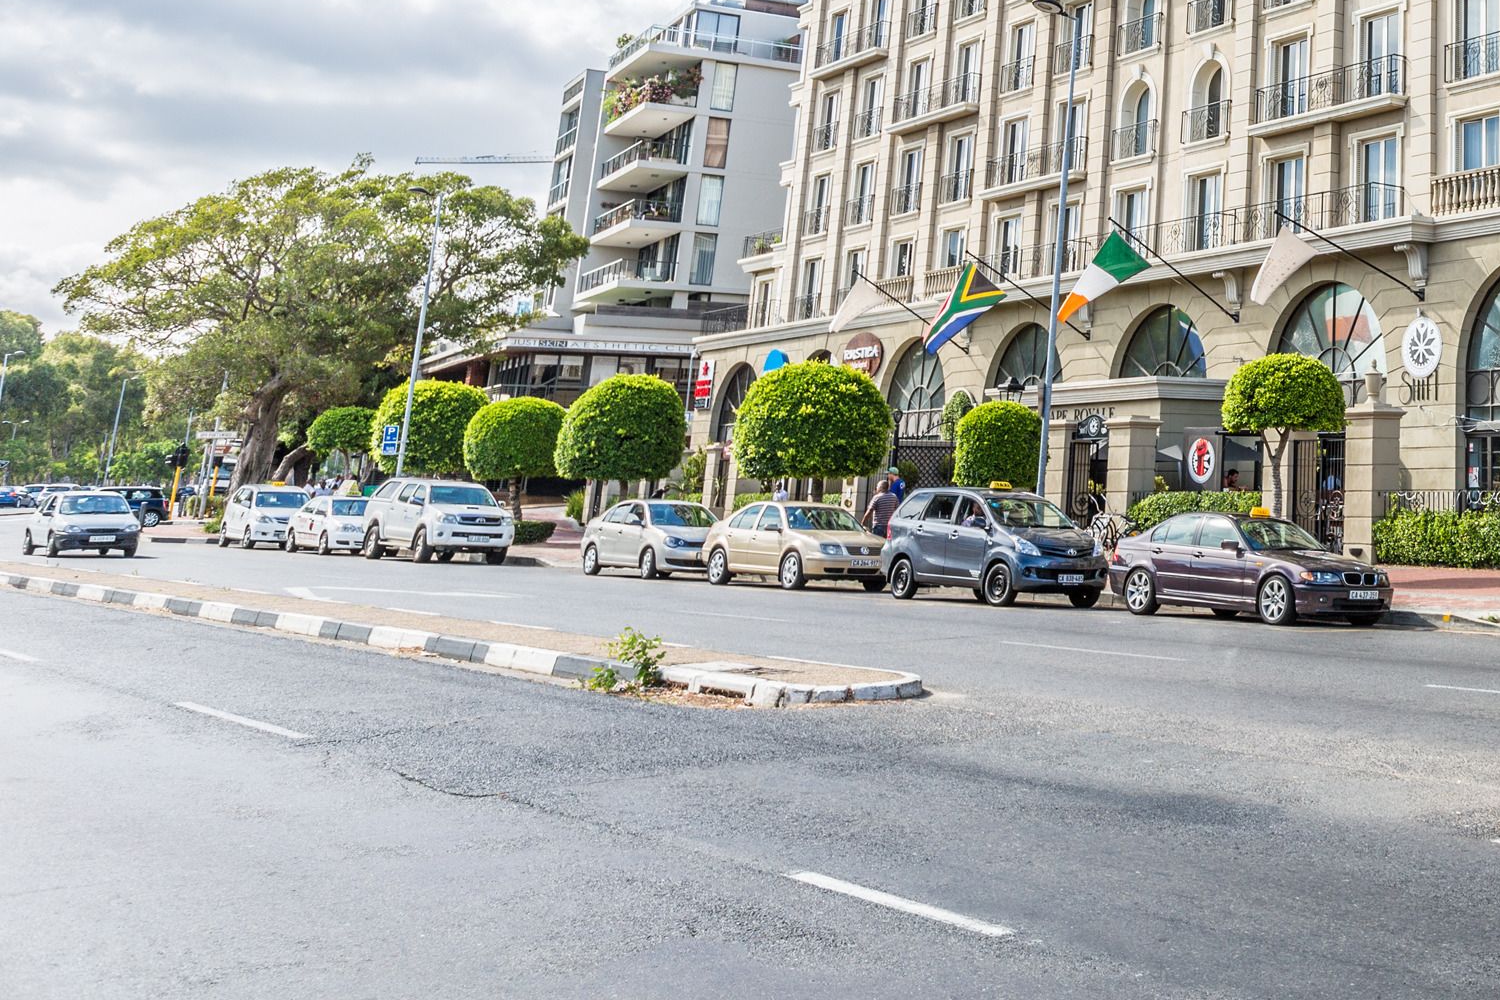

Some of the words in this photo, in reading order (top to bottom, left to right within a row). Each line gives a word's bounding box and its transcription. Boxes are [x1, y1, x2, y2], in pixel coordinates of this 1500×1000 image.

[571, 341, 657, 351] AESTHETIC
[1050, 409, 1068, 420] APE
[387, 427, 396, 435] P
